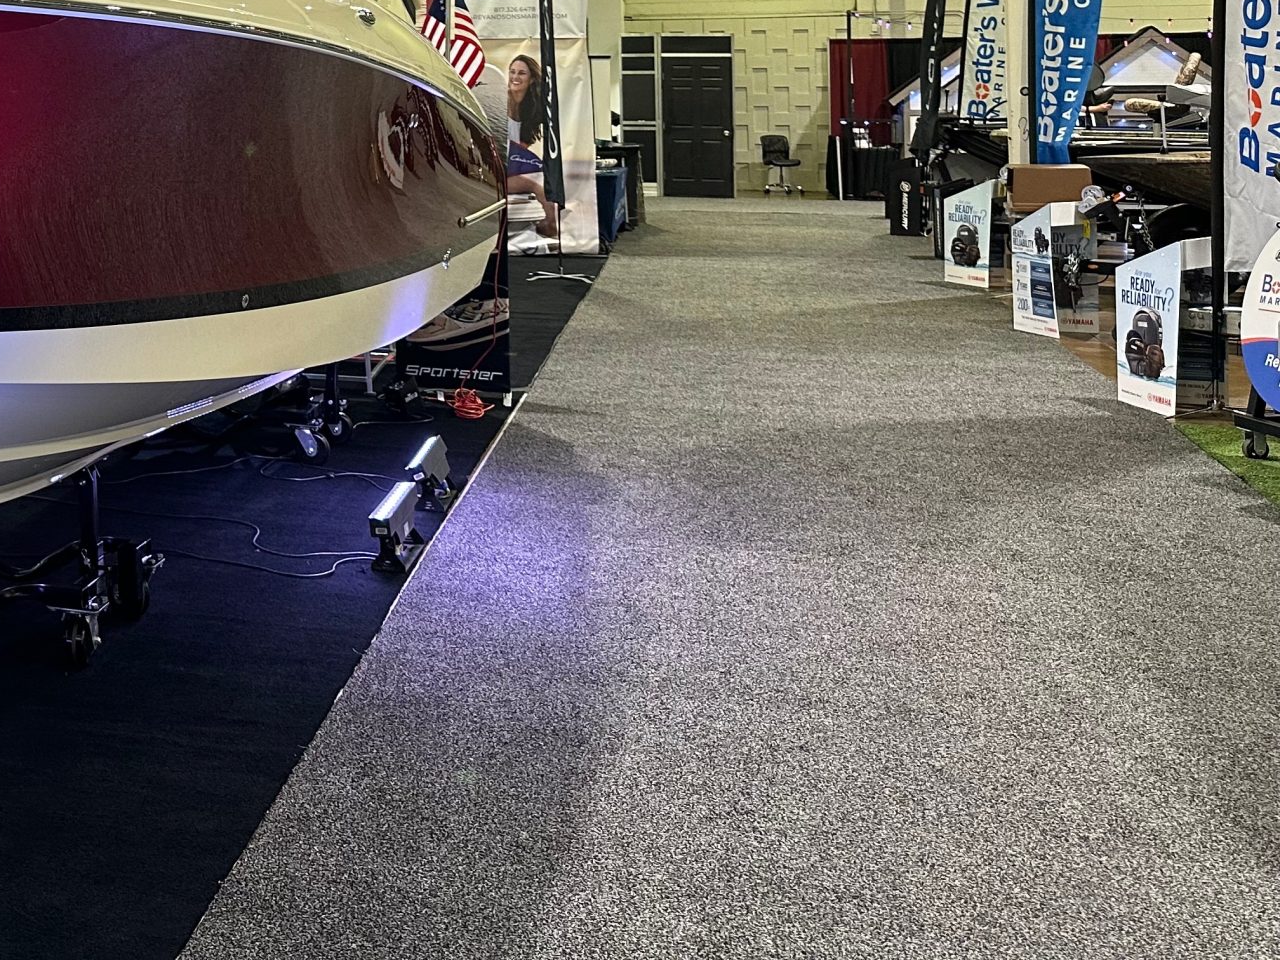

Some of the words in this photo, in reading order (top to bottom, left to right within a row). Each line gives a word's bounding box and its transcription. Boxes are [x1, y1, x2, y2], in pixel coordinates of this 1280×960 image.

[967, 16, 998, 119] Boater's
[1055, 37, 1087, 142] MARINE
[1130, 276, 1155, 294] READY
